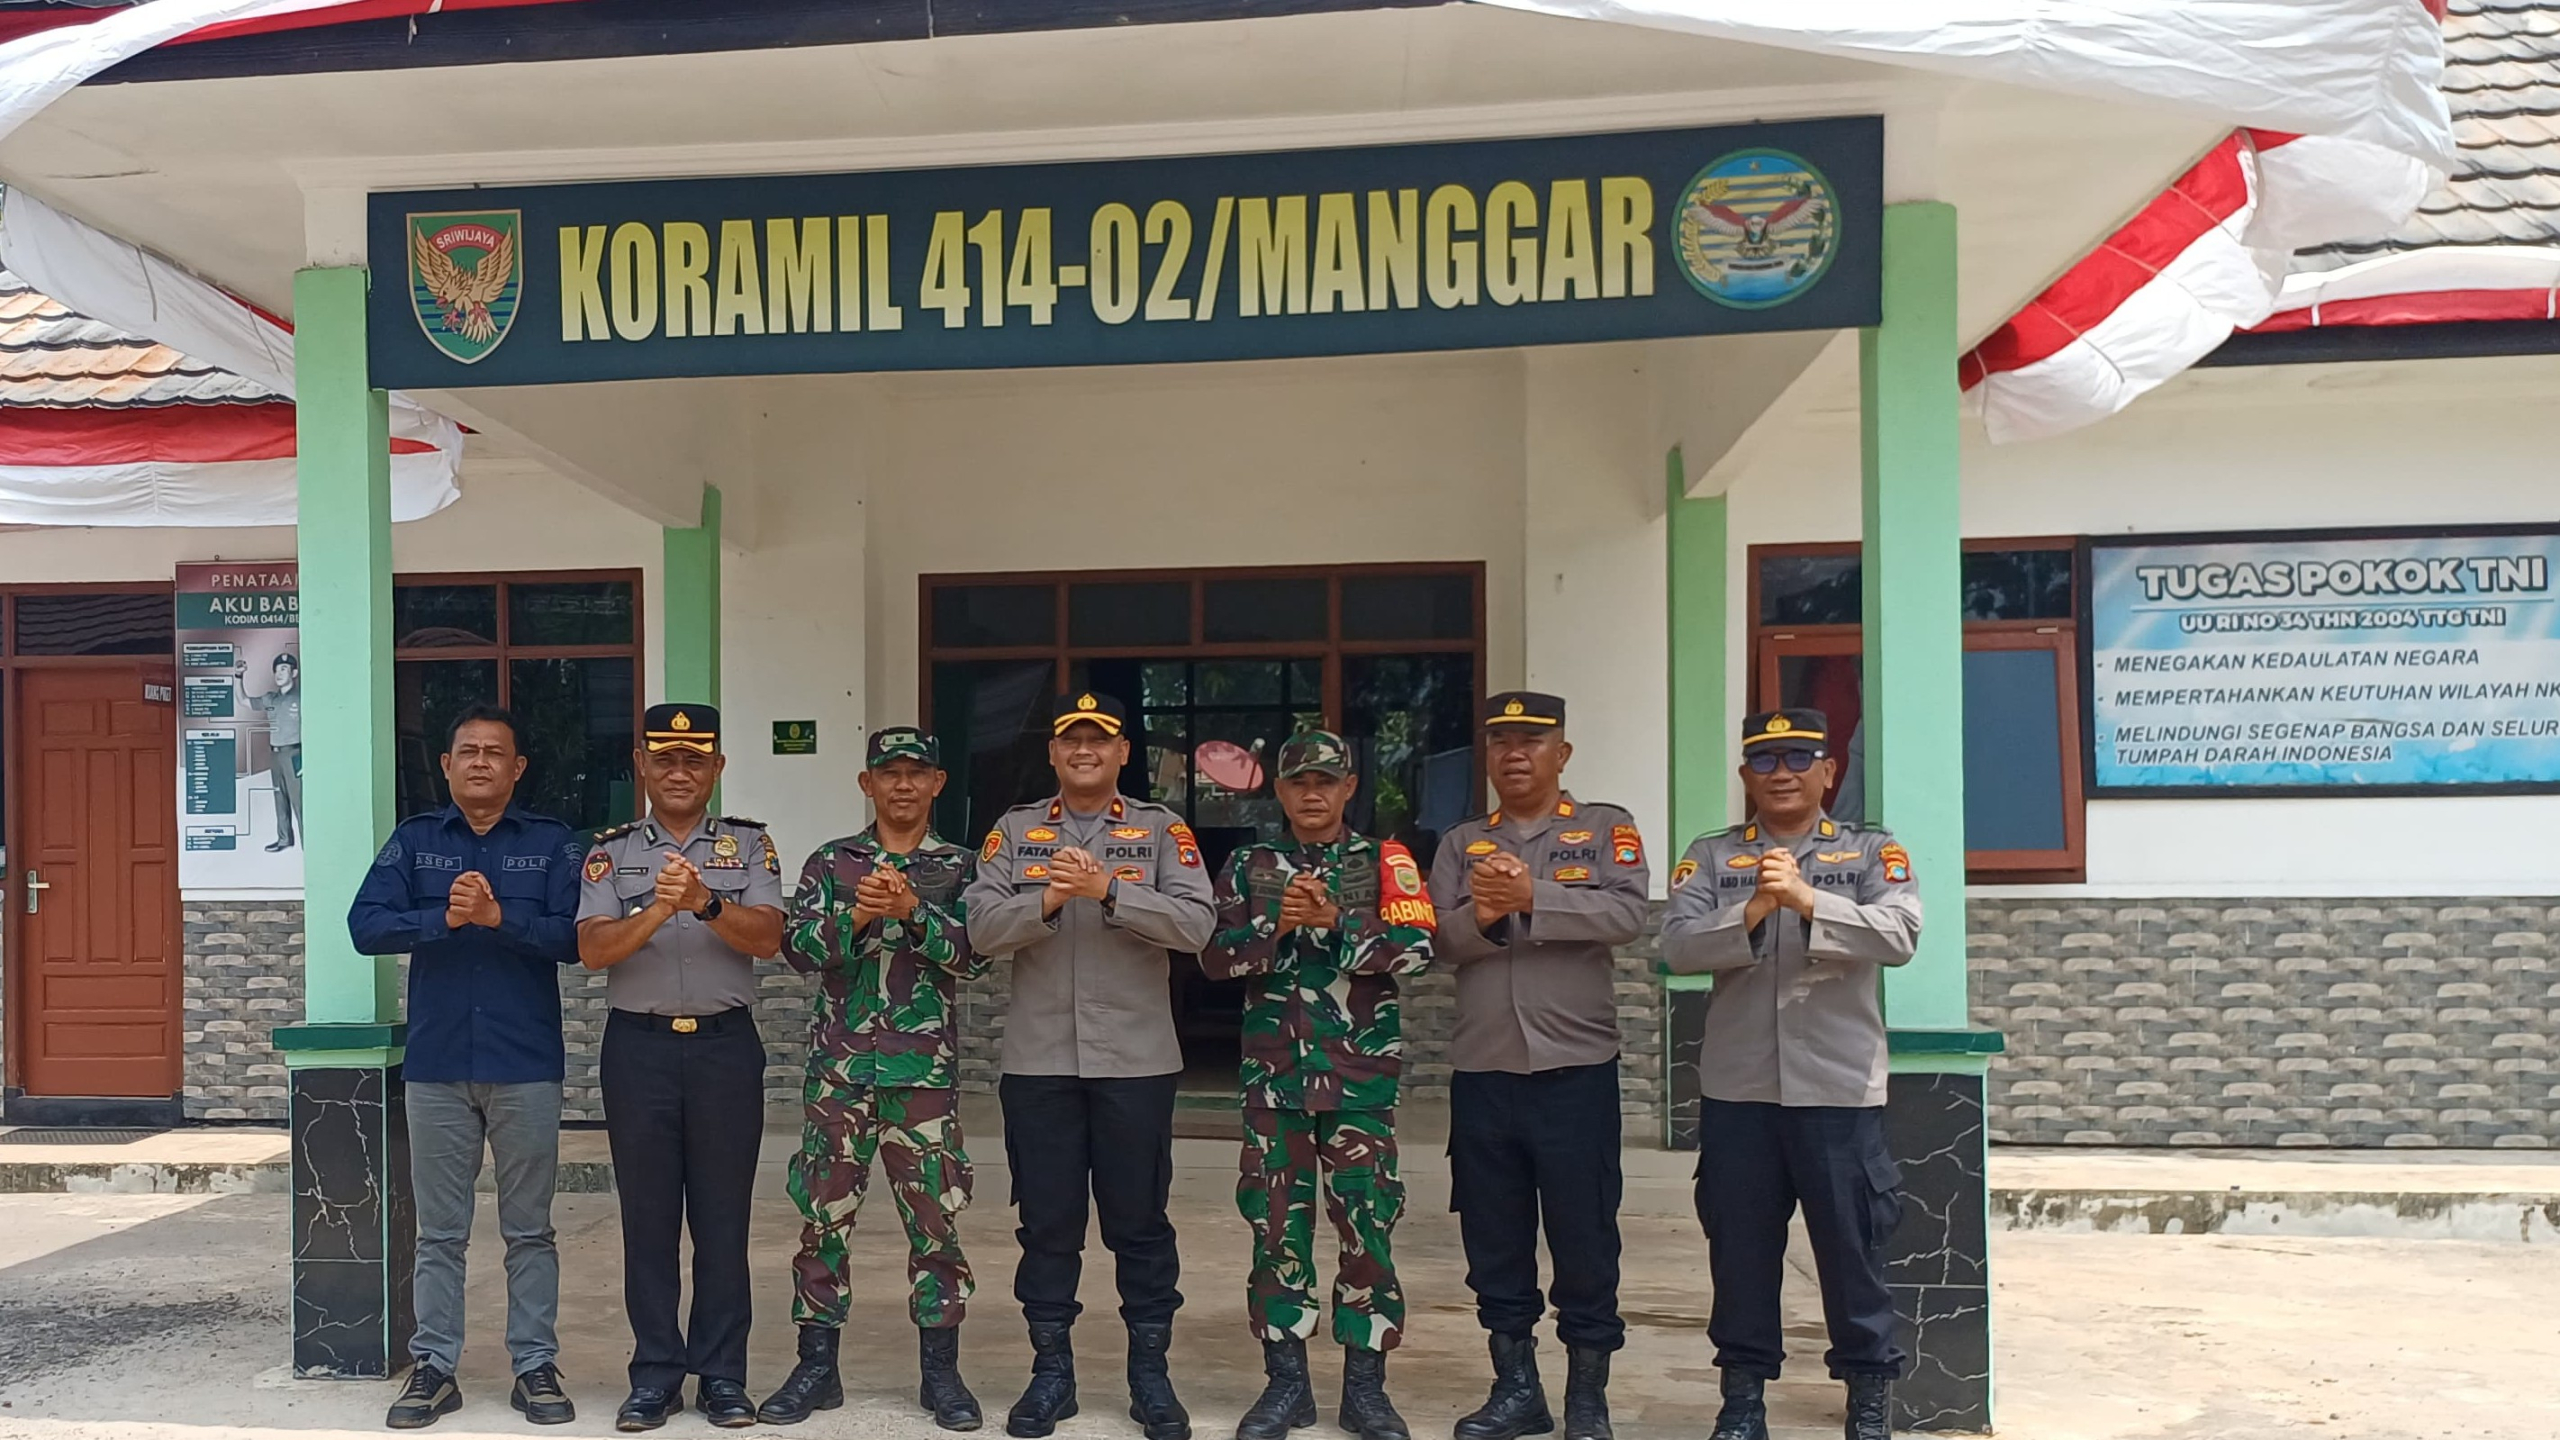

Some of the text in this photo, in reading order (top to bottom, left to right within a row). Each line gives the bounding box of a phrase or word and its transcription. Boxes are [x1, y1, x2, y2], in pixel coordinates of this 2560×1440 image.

[436, 229, 495, 248] SRIWIJAYA
[558, 176, 1655, 342] KORAMIL 414-02/MANGGAR
[211, 573, 298, 587] PENATAA
[2137, 555, 2548, 600] TUGAS POKOK TNI
[209, 597, 253, 613] AKU
[224, 614, 259, 625] KODIM
[2180, 607, 2506, 633] UU RI NO 34 THN 2004 TTG TNI
[2114, 649, 2479, 672] MENEGAKAN KEDAULATAN NEGARA
[2115, 686, 2315, 706] MEMPERTAHANKAN
[2320, 684, 2433, 701] KEUTUHAN
[2438, 682, 2529, 700] WILAYAH
[2115, 719, 2560, 742] MELINDUNGI SEGENAP BANGSA DAN SELUR
[2116, 745, 2392, 764] TUMPAH DARAH INDONESIA
[1105, 846, 1153, 858] POLRI
[1549, 849, 1596, 862] POLRI
